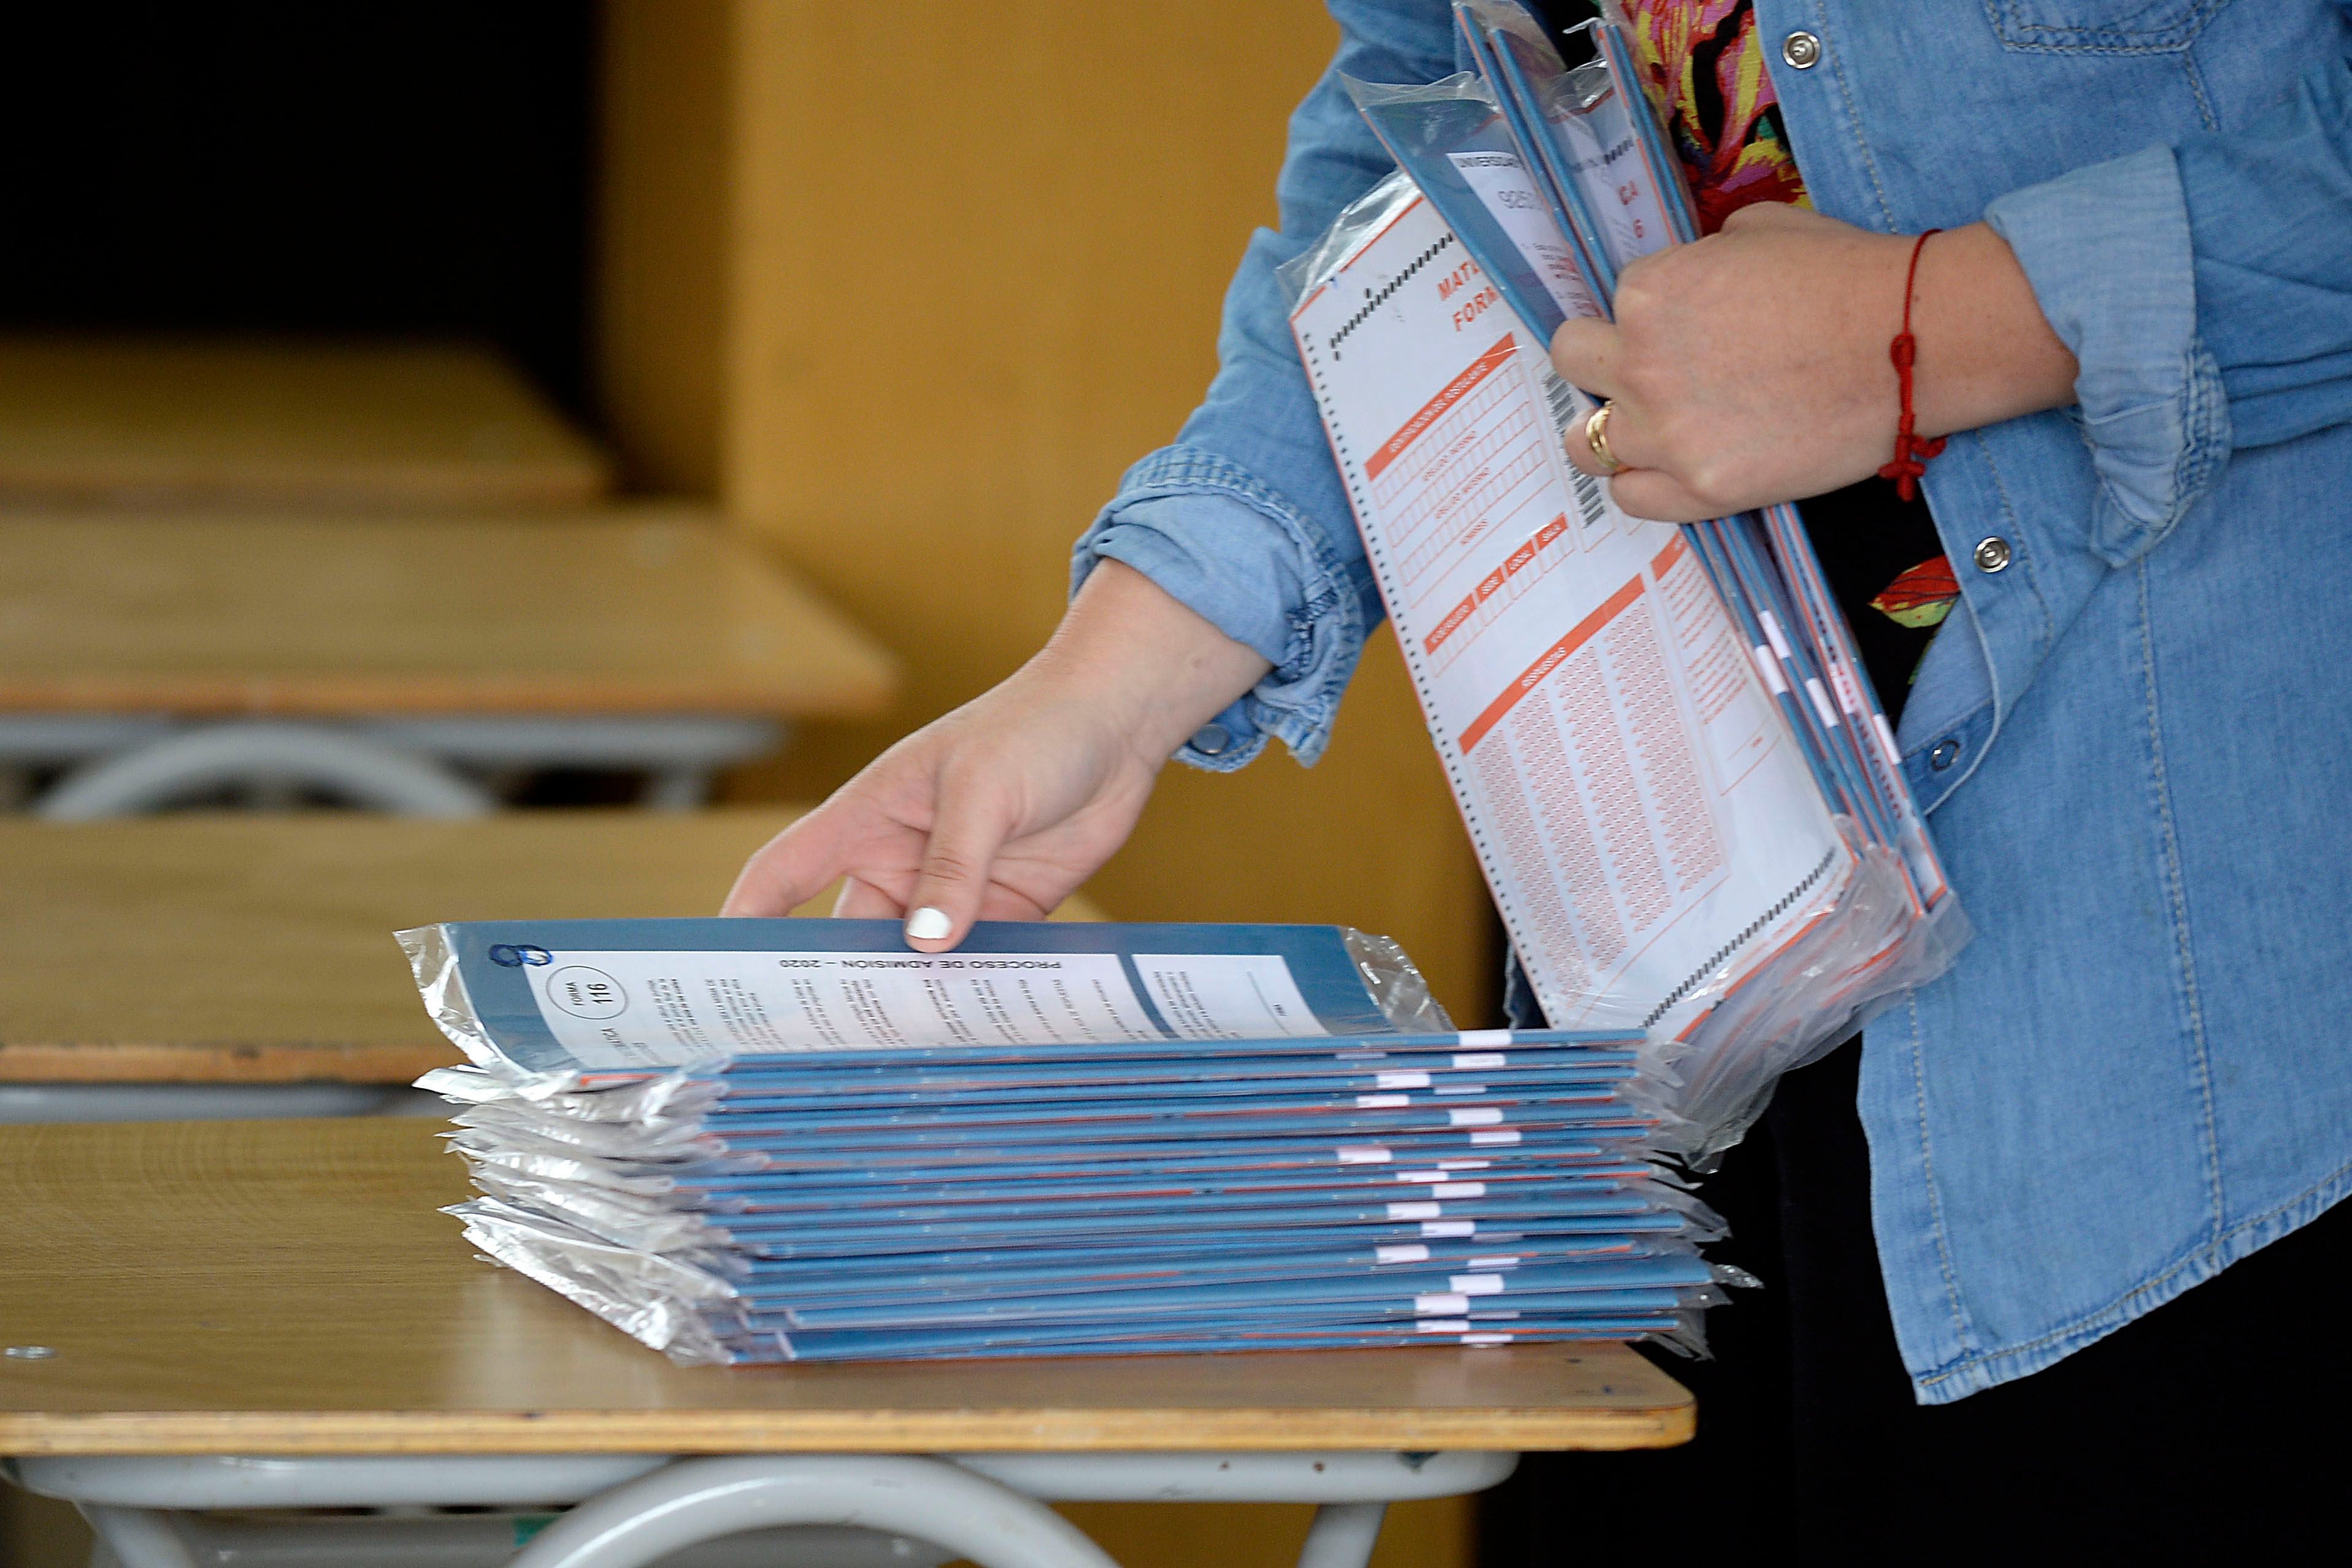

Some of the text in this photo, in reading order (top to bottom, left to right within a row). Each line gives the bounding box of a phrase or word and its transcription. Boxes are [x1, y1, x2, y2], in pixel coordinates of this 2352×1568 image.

[779, 959, 821, 968] 2020
[841, 960, 932, 970] ADMISIÓN
[970, 960, 1062, 969] PROCESO
[565, 982, 585, 1007] FORMA
[587, 983, 614, 1004] 116
